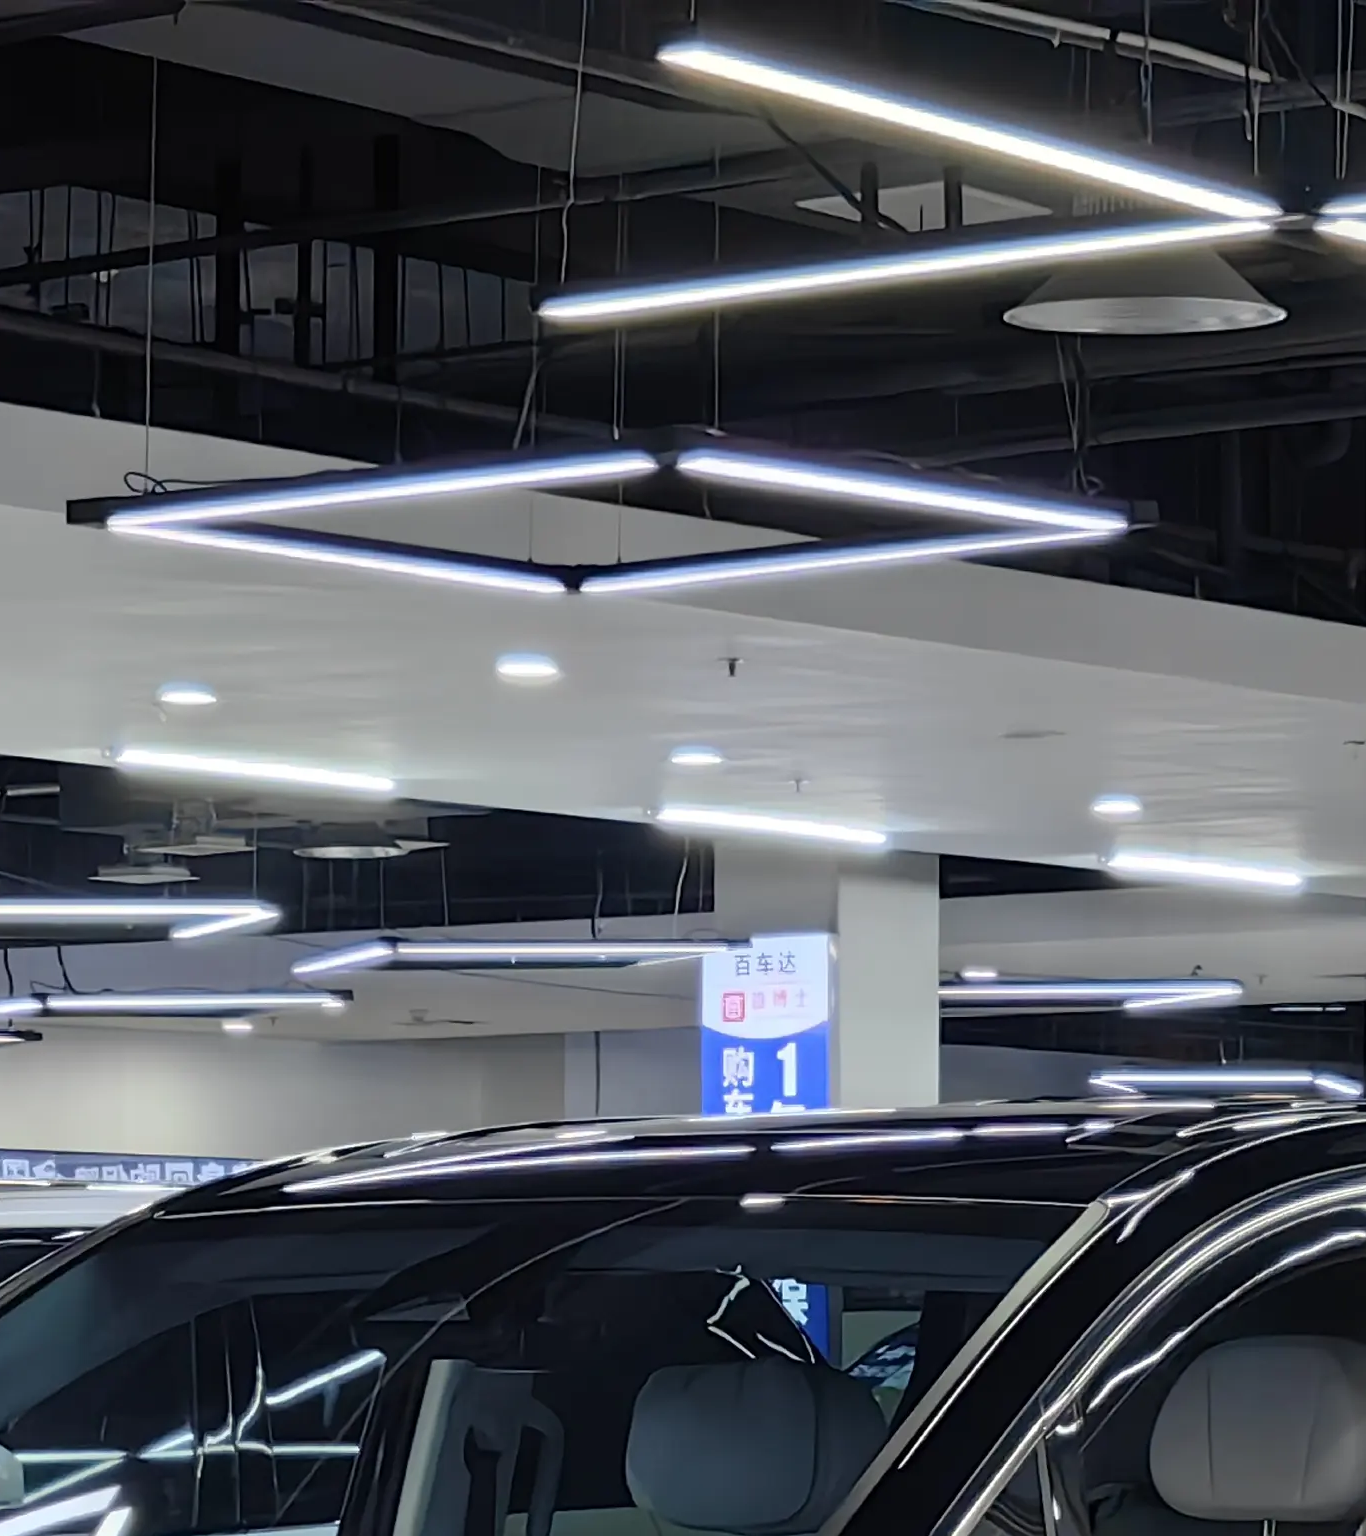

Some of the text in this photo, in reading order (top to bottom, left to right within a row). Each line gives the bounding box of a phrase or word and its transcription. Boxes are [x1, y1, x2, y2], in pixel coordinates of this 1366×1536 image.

[734, 951, 797, 977] 百车达
[771, 1042, 806, 1114] 1
